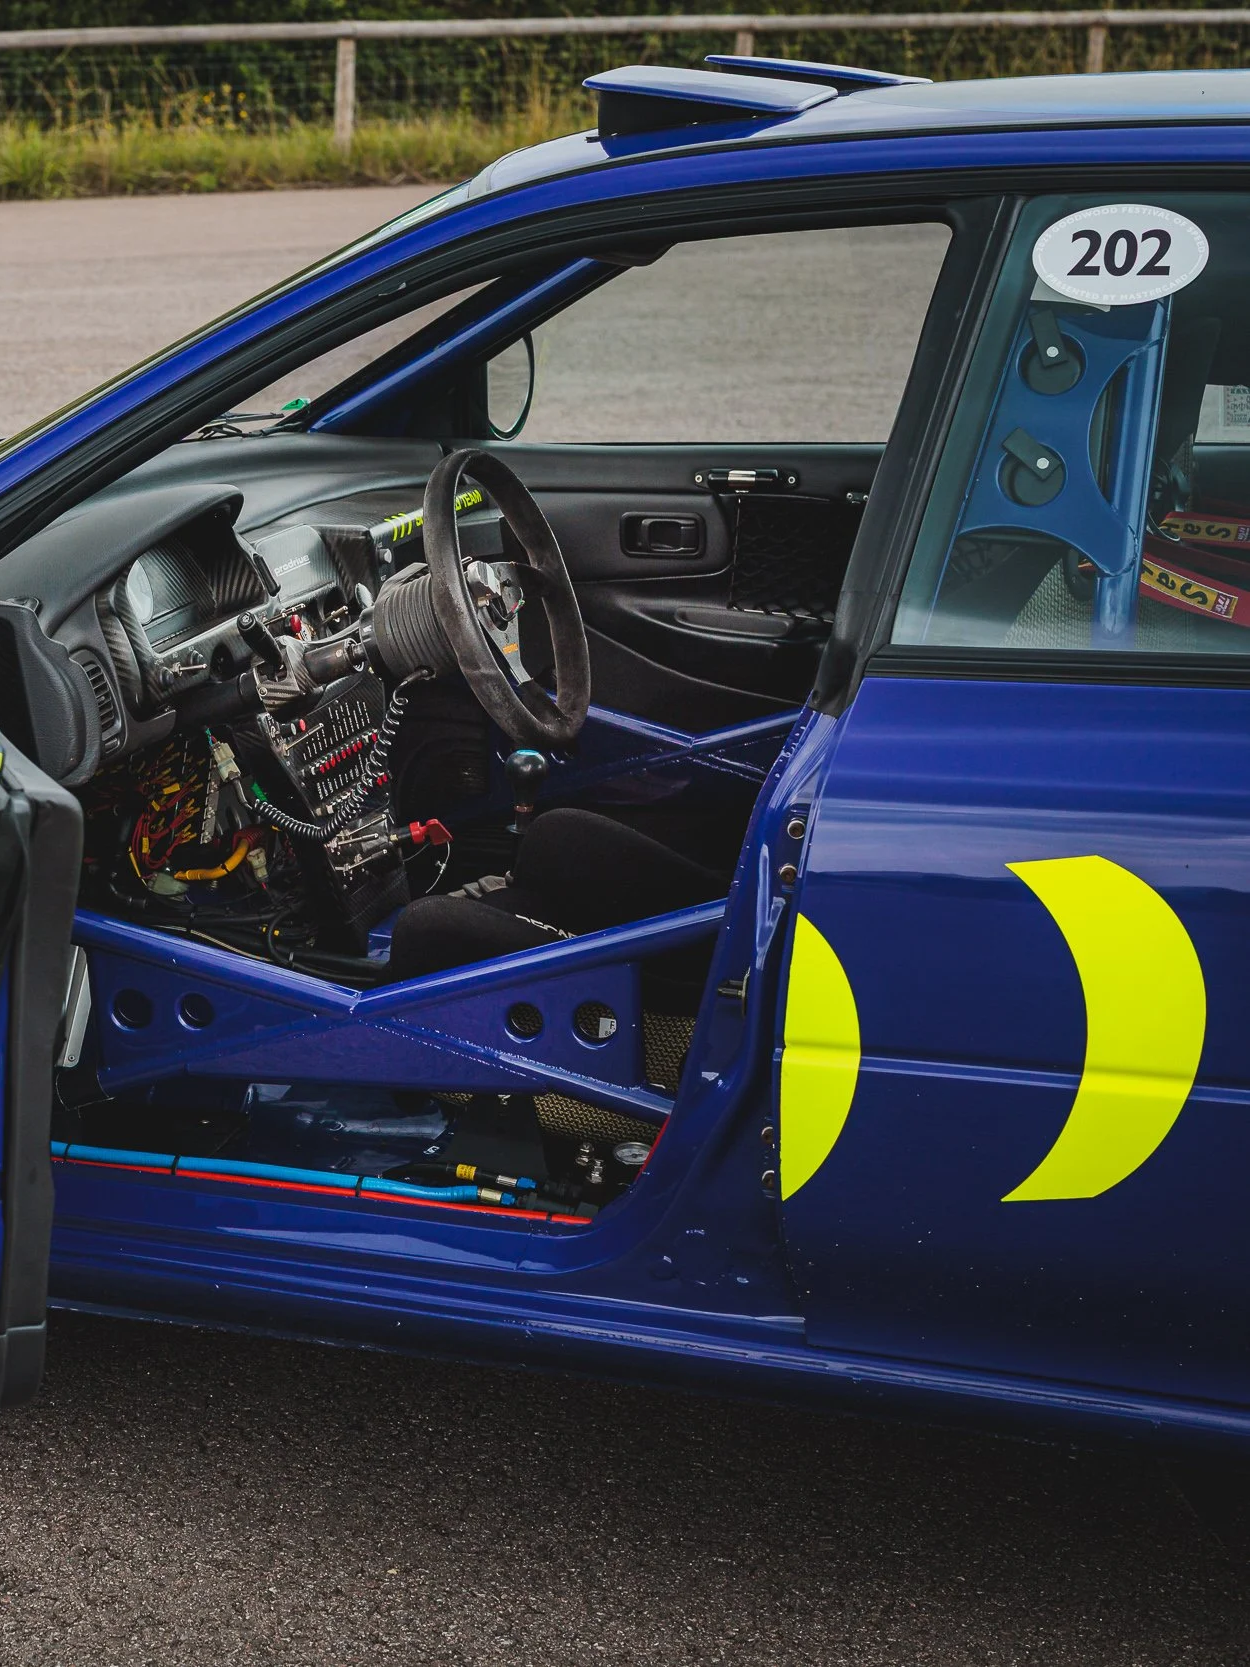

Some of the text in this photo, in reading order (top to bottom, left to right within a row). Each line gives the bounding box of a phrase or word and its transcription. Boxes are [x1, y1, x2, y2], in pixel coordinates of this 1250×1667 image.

[1053, 207, 1118, 233] GOODWOOD
[1122, 206, 1170, 221] FESTIVAL
[1173, 216, 1187, 229] OF
[1186, 226, 1207, 254] SPEED
[1067, 229, 1172, 277] 202
[1046, 273, 1100, 300] PRESENTED
[1119, 273, 1189, 301] MASTERCARD
[273, 554, 310, 577] prodrive
